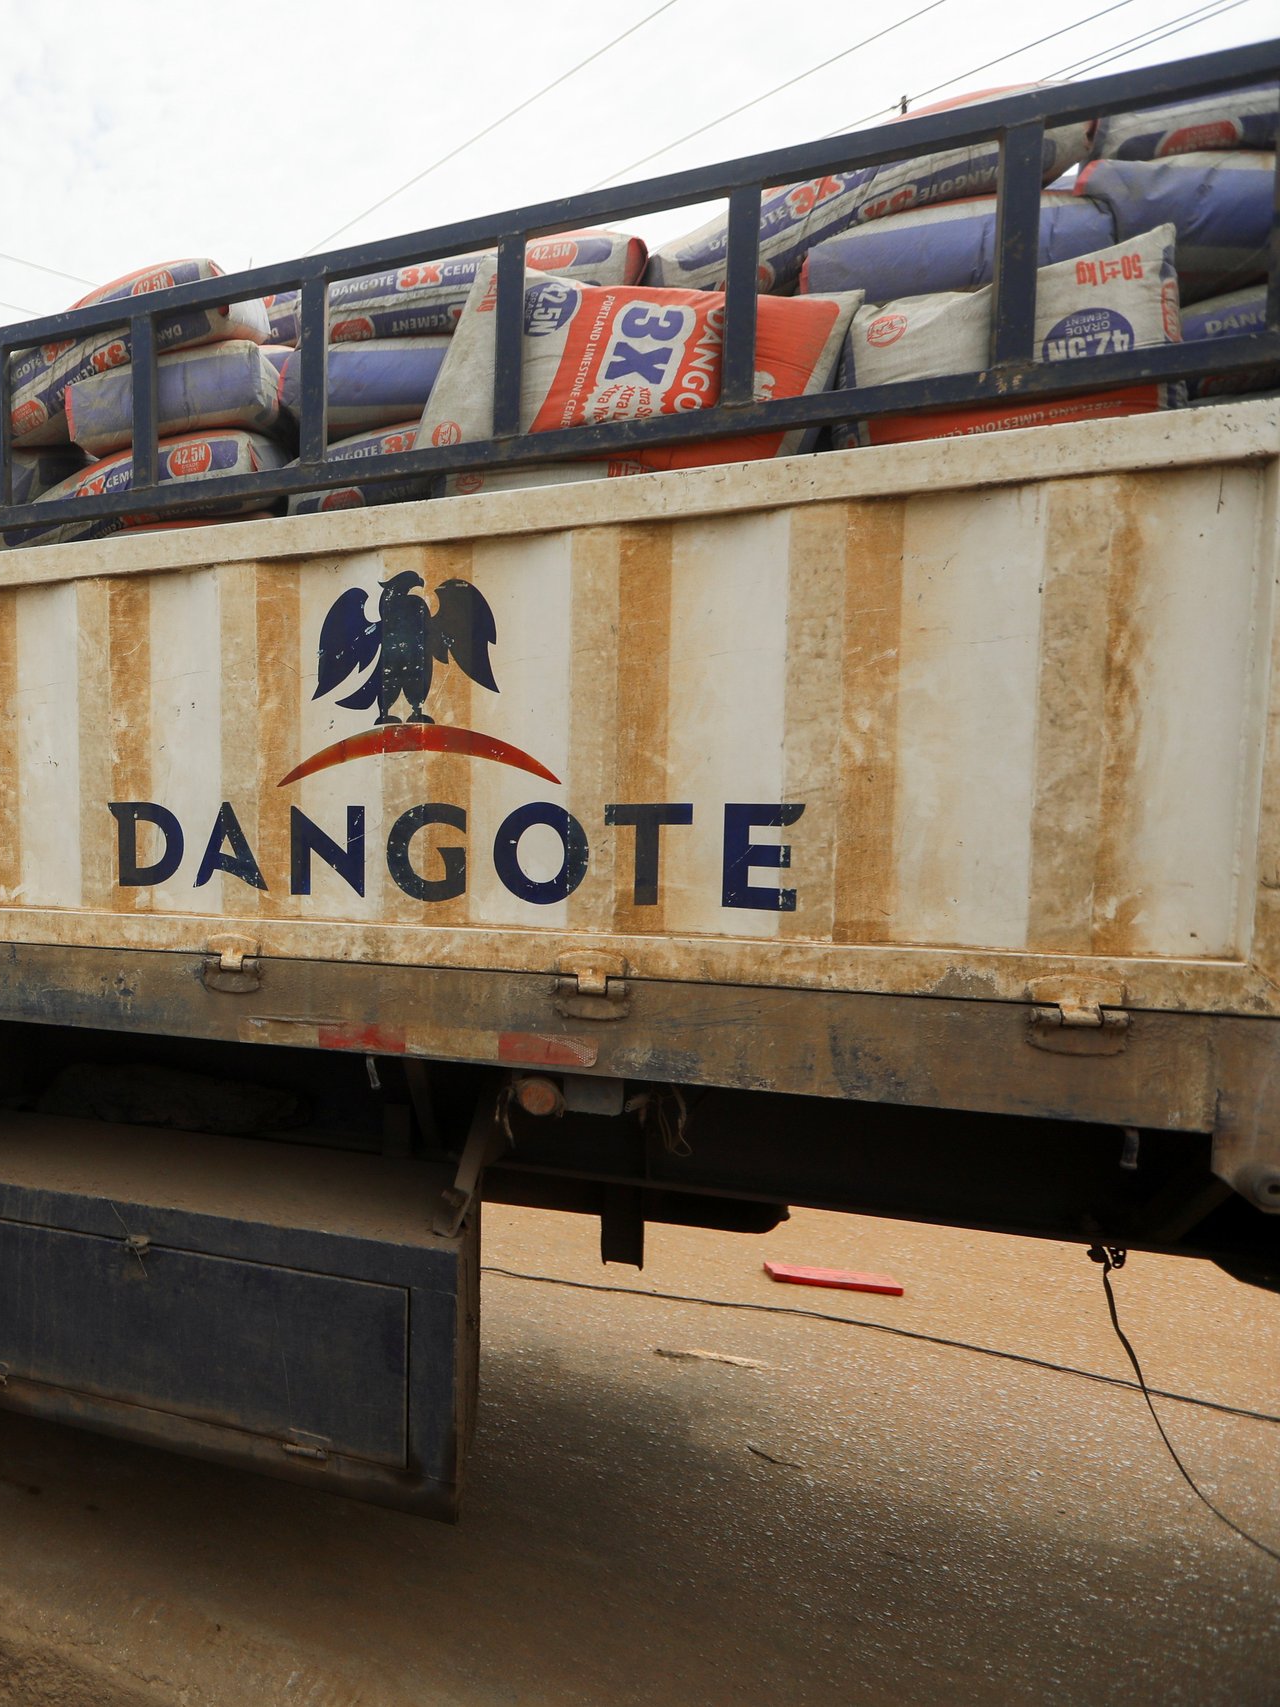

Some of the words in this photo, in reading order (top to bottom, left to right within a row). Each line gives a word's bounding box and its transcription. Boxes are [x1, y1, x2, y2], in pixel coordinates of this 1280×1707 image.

[531, 243, 572, 260] 42.5N
[331, 274, 394, 298] DANGOTE
[398, 263, 442, 290] 3X
[443, 261, 481, 277] CEM
[391, 313, 447, 334] CEMENT
[589, 294, 616, 341] PORTLAND
[1065, 311, 1110, 328] CEMENT
[1066, 320, 1110, 336] GRADE
[605, 306, 684, 384] 3X
[569, 343, 597, 398] LIMESTONE
[673, 308, 725, 413] DANGO
[560, 399, 578, 429] CEME
[967, 411, 1045, 435] LIMESTONE
[174, 445, 205, 465] 42.5N
[106, 468, 134, 488] CEM
[110, 801, 806, 911] DANGOTE
